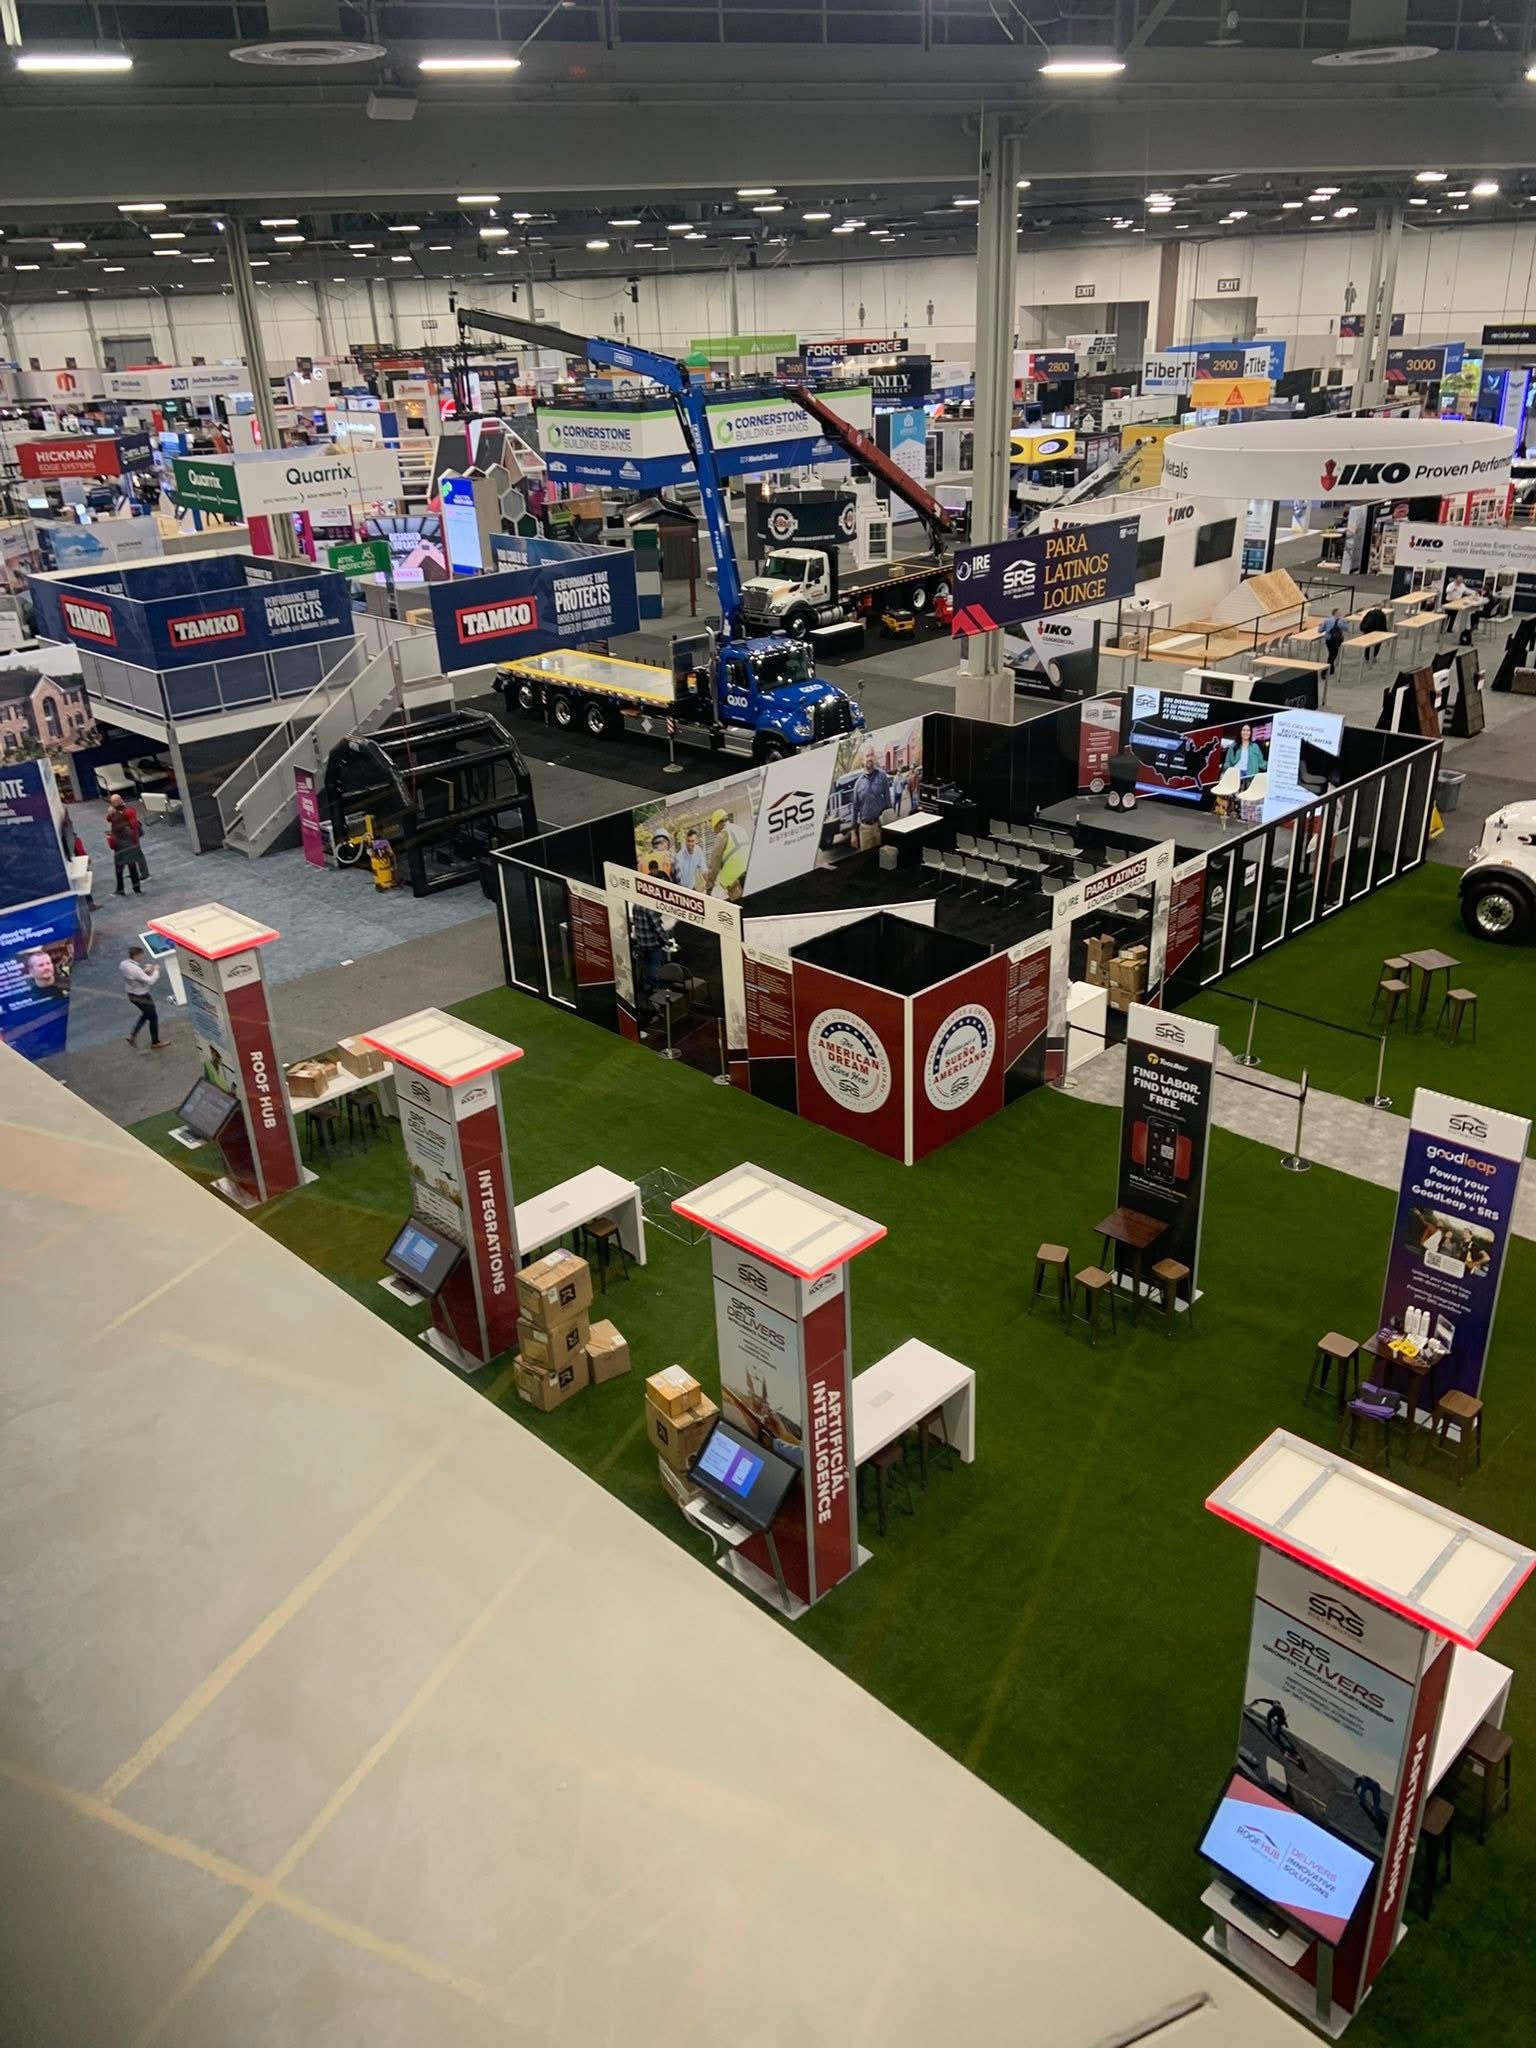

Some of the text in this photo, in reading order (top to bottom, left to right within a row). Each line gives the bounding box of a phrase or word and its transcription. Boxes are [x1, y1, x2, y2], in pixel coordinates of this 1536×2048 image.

[1076, 285, 1095, 297] EXIT
[1219, 279, 1239, 290] EXIT
[807, 345, 848, 357] FORCE
[864, 341, 901, 354] FORCE
[1048, 362, 1069, 372] 2800
[1213, 360, 1239, 372] 2900
[1406, 359, 1436, 371] 3000
[735, 410, 808, 429] CORNERSTONE
[736, 422, 809, 441] BUILDING BRANDS
[562, 425, 631, 440] CORNERSTONE
[36, 449, 94, 462] HICKMAN
[564, 438, 632, 452] BUILDING BRANDS
[39, 462, 96, 471] EDGE SYSTEMS
[286, 462, 352, 485] Quarrix
[1338, 462, 1468, 486] IKO Proven
[188, 468, 223, 490] Quarrix
[1173, 505, 1195, 522] IKO
[1045, 533, 1088, 559] PARA
[1416, 537, 1444, 549] IKO
[973, 554, 991, 571] IRE
[1044, 553, 1109, 585] LATINOS
[553, 571, 609, 592] PERFORMANCE THAT
[1003, 567, 1036, 590] SRS
[555, 583, 611, 613] PROTECTS
[1043, 578, 1106, 611] LOUNGE
[65, 602, 112, 638] TAMKO
[266, 600, 324, 628] PROTECTS
[463, 603, 532, 636] TAMKO
[174, 614, 240, 641] TAMKO
[1044, 624, 1072, 636] IKO
[799, 684, 824, 693] QXO
[727, 695, 748, 708] QXO
[768, 799, 814, 834] SRS
[619, 878, 630, 889] IRE
[1086, 861, 1146, 898] PARA LATINOS
[637, 881, 704, 913] PARA LATINOS
[1068, 895, 1079, 907] IRE
[1088, 876, 1146, 910] LOUNGE ENTRADA
[655, 901, 705, 925] LOUNGE EXIT
[1155, 1026, 1185, 1044] SRS
[818, 1039, 879, 1070] AMERICAN
[828, 1052, 869, 1076] DREAM
[933, 1049, 987, 1084] AMERICANO
[945, 1045, 975, 1068] SUEÑO
[250, 1051, 277, 1130] ROOF HUB
[839, 1081, 860, 1097] SRS
[1132, 1065, 1201, 1095] FIND LABOR.
[1133, 1077, 1199, 1106] FIND WORK.
[1149, 1093, 1180, 1111] FREE.
[1449, 1118, 1487, 1139] SRS
[1426, 1145, 1497, 1176] goodleap
[1429, 1165, 1490, 1193] Power your
[1411, 1184, 1467, 1211] GoodLeap
[1477, 1206, 1500, 1221] SRS
[1423, 1178, 1488, 1205] growth with
[478, 1168, 506, 1296] INTEGRATIONS
[738, 1267, 768, 1292] SRS
[731, 1297, 756, 1318] SRS
[727, 1305, 785, 1346] DELIVERS
[813, 1380, 832, 1525] INTELLIGENCE
[827, 1390, 846, 1501] ARTIFICIAL
[1309, 1597, 1364, 1637] SRS
[1286, 1630, 1330, 1664] SRS
[1263, 1644, 1297, 1667] GROWTH
[1299, 1665, 1337, 1691] THROUGH
[1339, 1689, 1395, 1723] PARTNERSHIP
[1274, 1638, 1386, 1709] DELIVERS
[1236, 1826, 1281, 1861] ROOF HUB
[1286, 1857, 1337, 1893] INNOVATIVE
[1291, 1847, 1337, 1883] DELIVERS
[1283, 1865, 1330, 1899] SOLUTIONS
